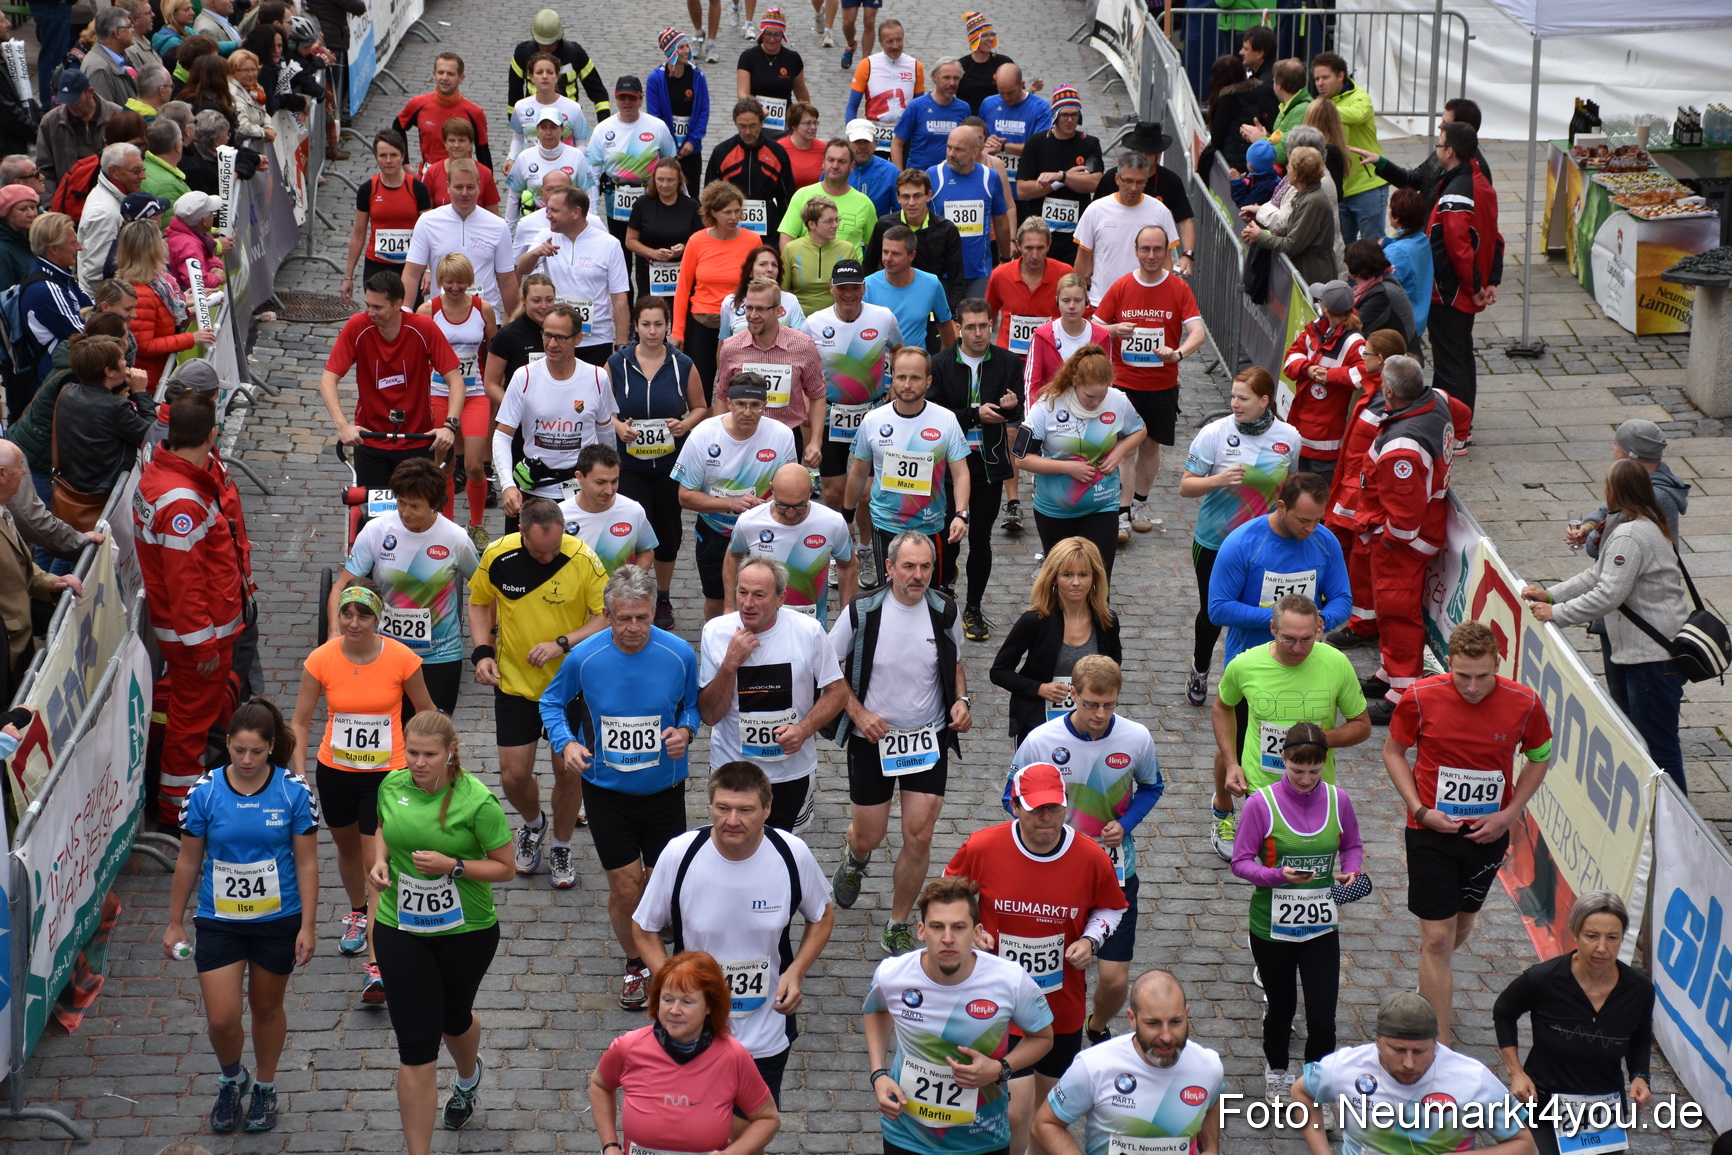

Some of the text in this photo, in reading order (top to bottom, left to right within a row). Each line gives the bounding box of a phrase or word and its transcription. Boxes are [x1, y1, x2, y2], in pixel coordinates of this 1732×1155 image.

[927, 120, 958, 129] HUBER
[995, 119, 1026, 129] HUBER
[221, 154, 233, 201] Laufsport
[218, 202, 229, 229] BMW
[953, 209, 977, 223] 380
[1045, 206, 1075, 222] 2458
[380, 238, 410, 252] 2041
[653, 269, 680, 283] 256
[1121, 309, 1165, 318] NEUMARKT
[1125, 337, 1160, 352] 2501
[535, 417, 583, 432] twinn
[636, 429, 666, 446] 384
[635, 447, 667, 455] Alexandra
[885, 451, 901, 459] PARTL
[897, 460, 918, 477] 30
[897, 480, 915, 489] Maze
[1093, 483, 1106, 492] 16.
[711, 487, 725, 496] PARTL
[430, 548, 447, 557] Hervis
[1265, 575, 1285, 583] PARTL
[502, 583, 526, 593] Robert
[1273, 583, 1307, 602] 517
[383, 616, 426, 638] 2628
[1252, 689, 1331, 718] OPF
[334, 717, 352, 725] PARTL
[602, 720, 621, 728] PARTL
[761, 717, 790, 725] Neumarkt
[1262, 725, 1281, 735] PARTL
[344, 727, 380, 748] 164
[607, 729, 656, 750] 2803
[884, 730, 933, 756] 2076
[345, 752, 376, 762] Claudia
[620, 755, 640, 764] Josef
[896, 757, 926, 768] Günther
[1109, 757, 1129, 765] Hervis
[1440, 771, 1495, 782] PARTL Neumarkt
[1443, 780, 1498, 802] 2049
[1453, 806, 1484, 815] Bastian
[1286, 857, 1329, 867] NO MEAT
[215, 865, 266, 876] PARTL Neumarkt
[225, 876, 267, 899] 234
[399, 877, 446, 891] PARTL Neumarkt
[402, 889, 454, 912] 2763
[752, 899, 767, 910] m
[237, 903, 254, 912] Ilse
[994, 899, 1069, 918] NEUMARKT
[1278, 902, 1333, 924] 2295
[413, 916, 445, 926] Sabine
[1000, 938, 1055, 950] PARTL Neumarkt
[1005, 950, 1060, 973] 2653
[901, 1009, 924, 1019] PARTL
[970, 1004, 995, 1015] Hervis
[905, 1060, 928, 1075] PARTL
[914, 1076, 963, 1107] 212
[1184, 1090, 1205, 1102] Hervis
[663, 1094, 689, 1107] run
[1111, 1102, 1136, 1110] Neumarkt
[1112, 1096, 1136, 1105] PARTL
[918, 1106, 952, 1121] Martin
[1112, 1139, 1177, 1153] PARTL Neumarkt
[1580, 1135, 1601, 1147] Irina
